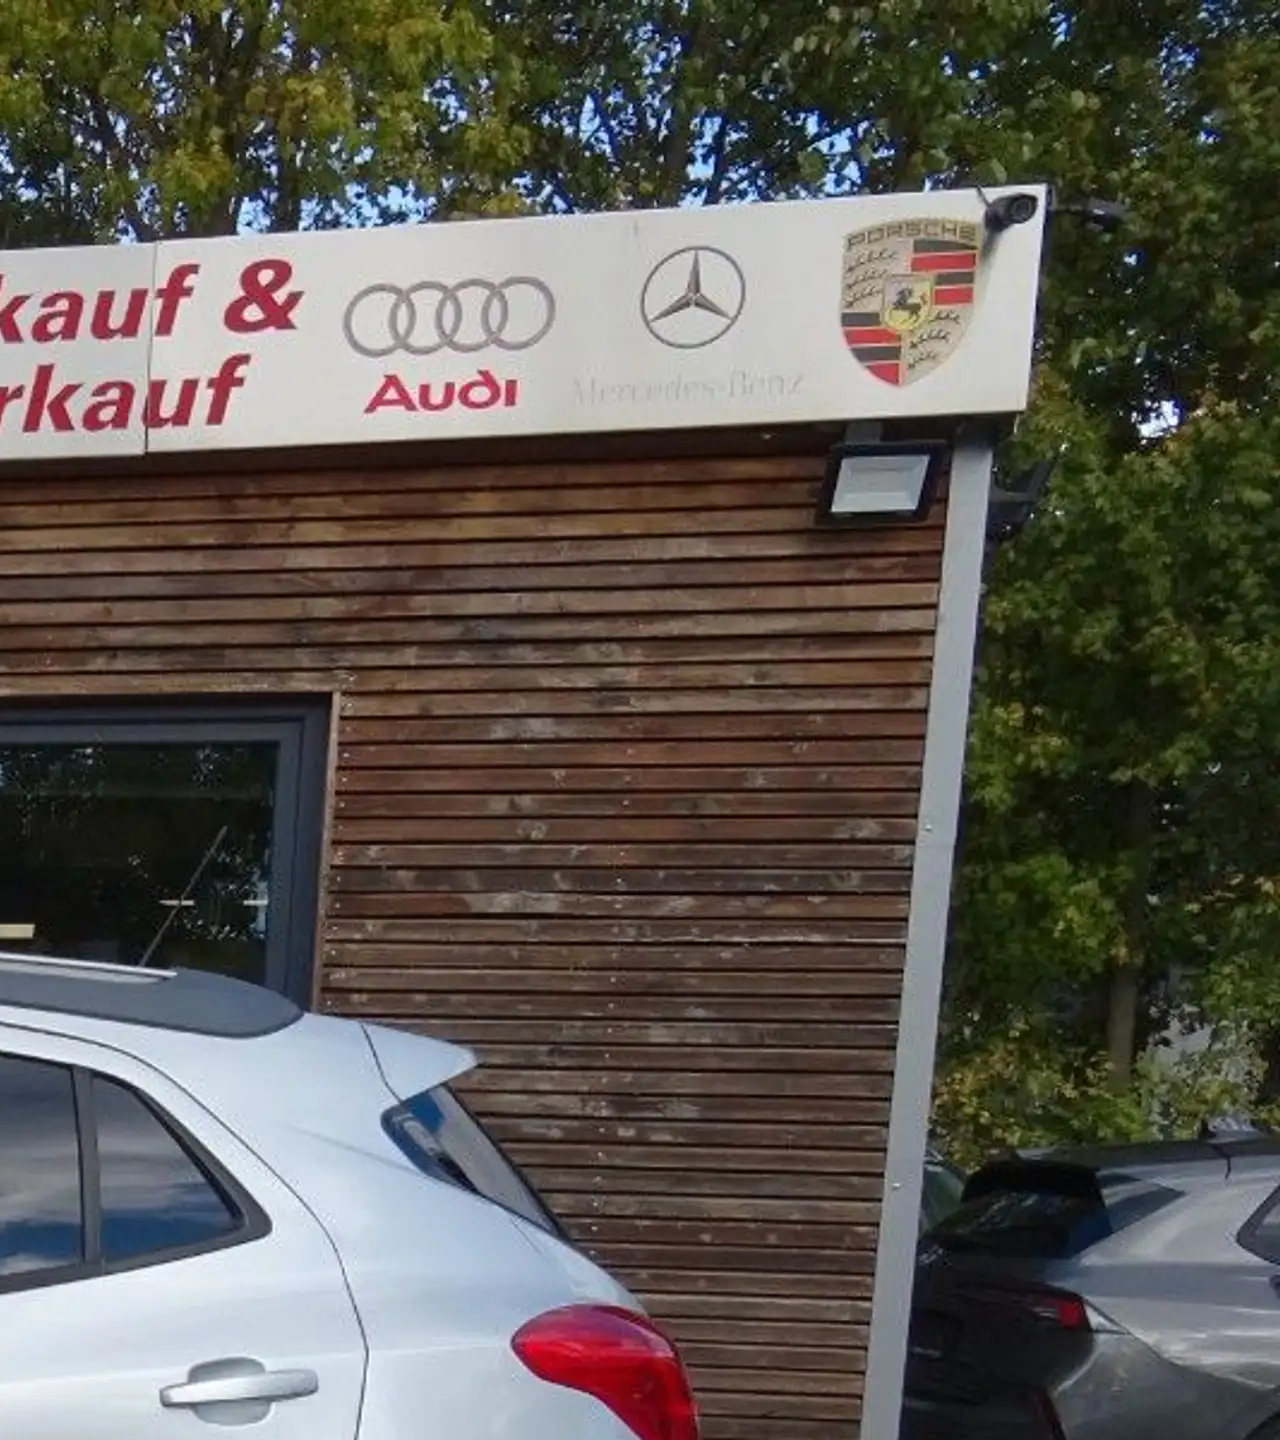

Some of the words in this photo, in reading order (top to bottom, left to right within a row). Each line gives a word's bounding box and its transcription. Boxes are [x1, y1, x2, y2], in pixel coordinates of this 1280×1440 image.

[847, 217, 977, 250] PORSCHE
[223, 259, 303, 332] &
[363, 369, 520, 414] Audi
